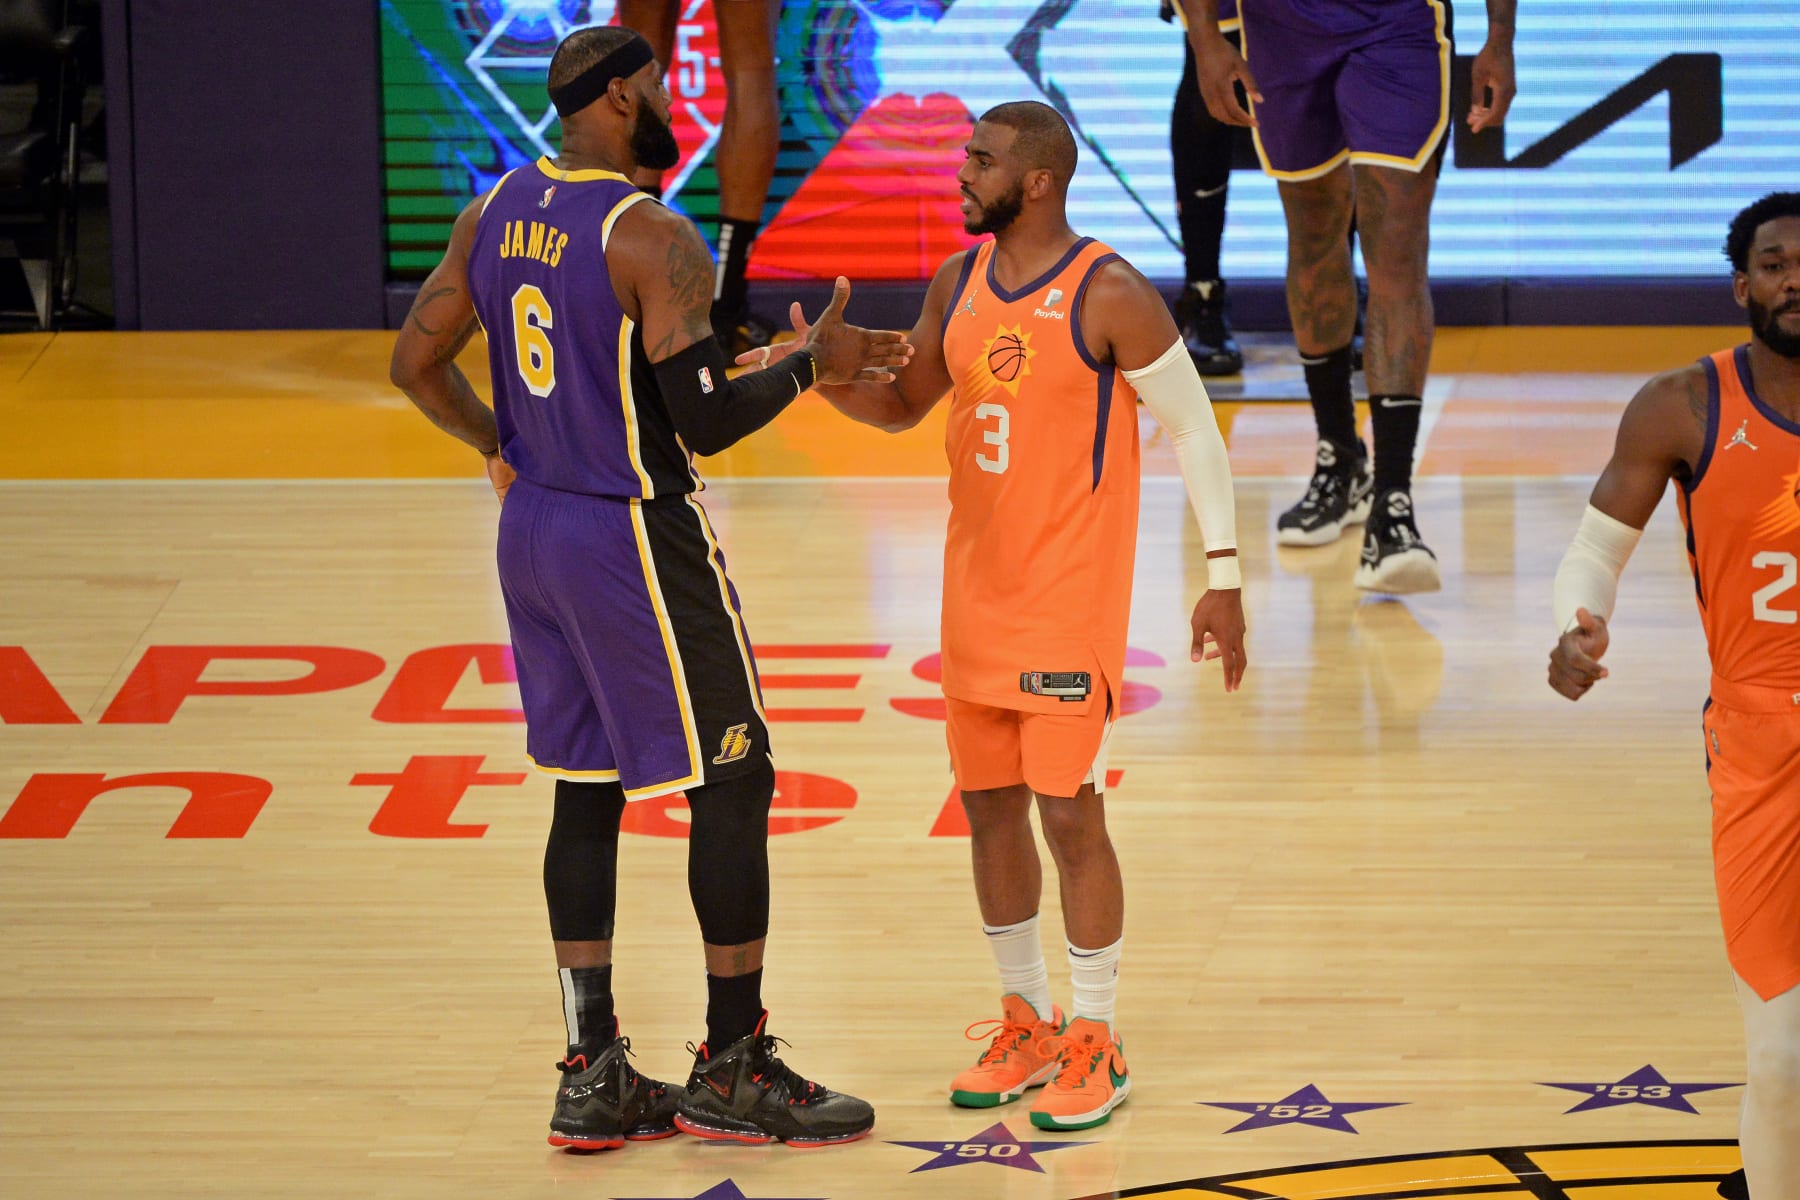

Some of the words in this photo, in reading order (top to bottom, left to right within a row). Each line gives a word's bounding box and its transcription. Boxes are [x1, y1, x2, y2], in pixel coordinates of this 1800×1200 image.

[663, 25, 706, 98] 5
[500, 219, 569, 269] JAMES
[1033, 307, 1065, 321] PayPal
[511, 283, 556, 399] 6
[975, 402, 1010, 474] 3
[1752, 551, 1798, 624] 2
[1255, 1104, 1333, 1118] '52
[1595, 1084, 1672, 1099] '53
[943, 1143, 1021, 1158] '50
